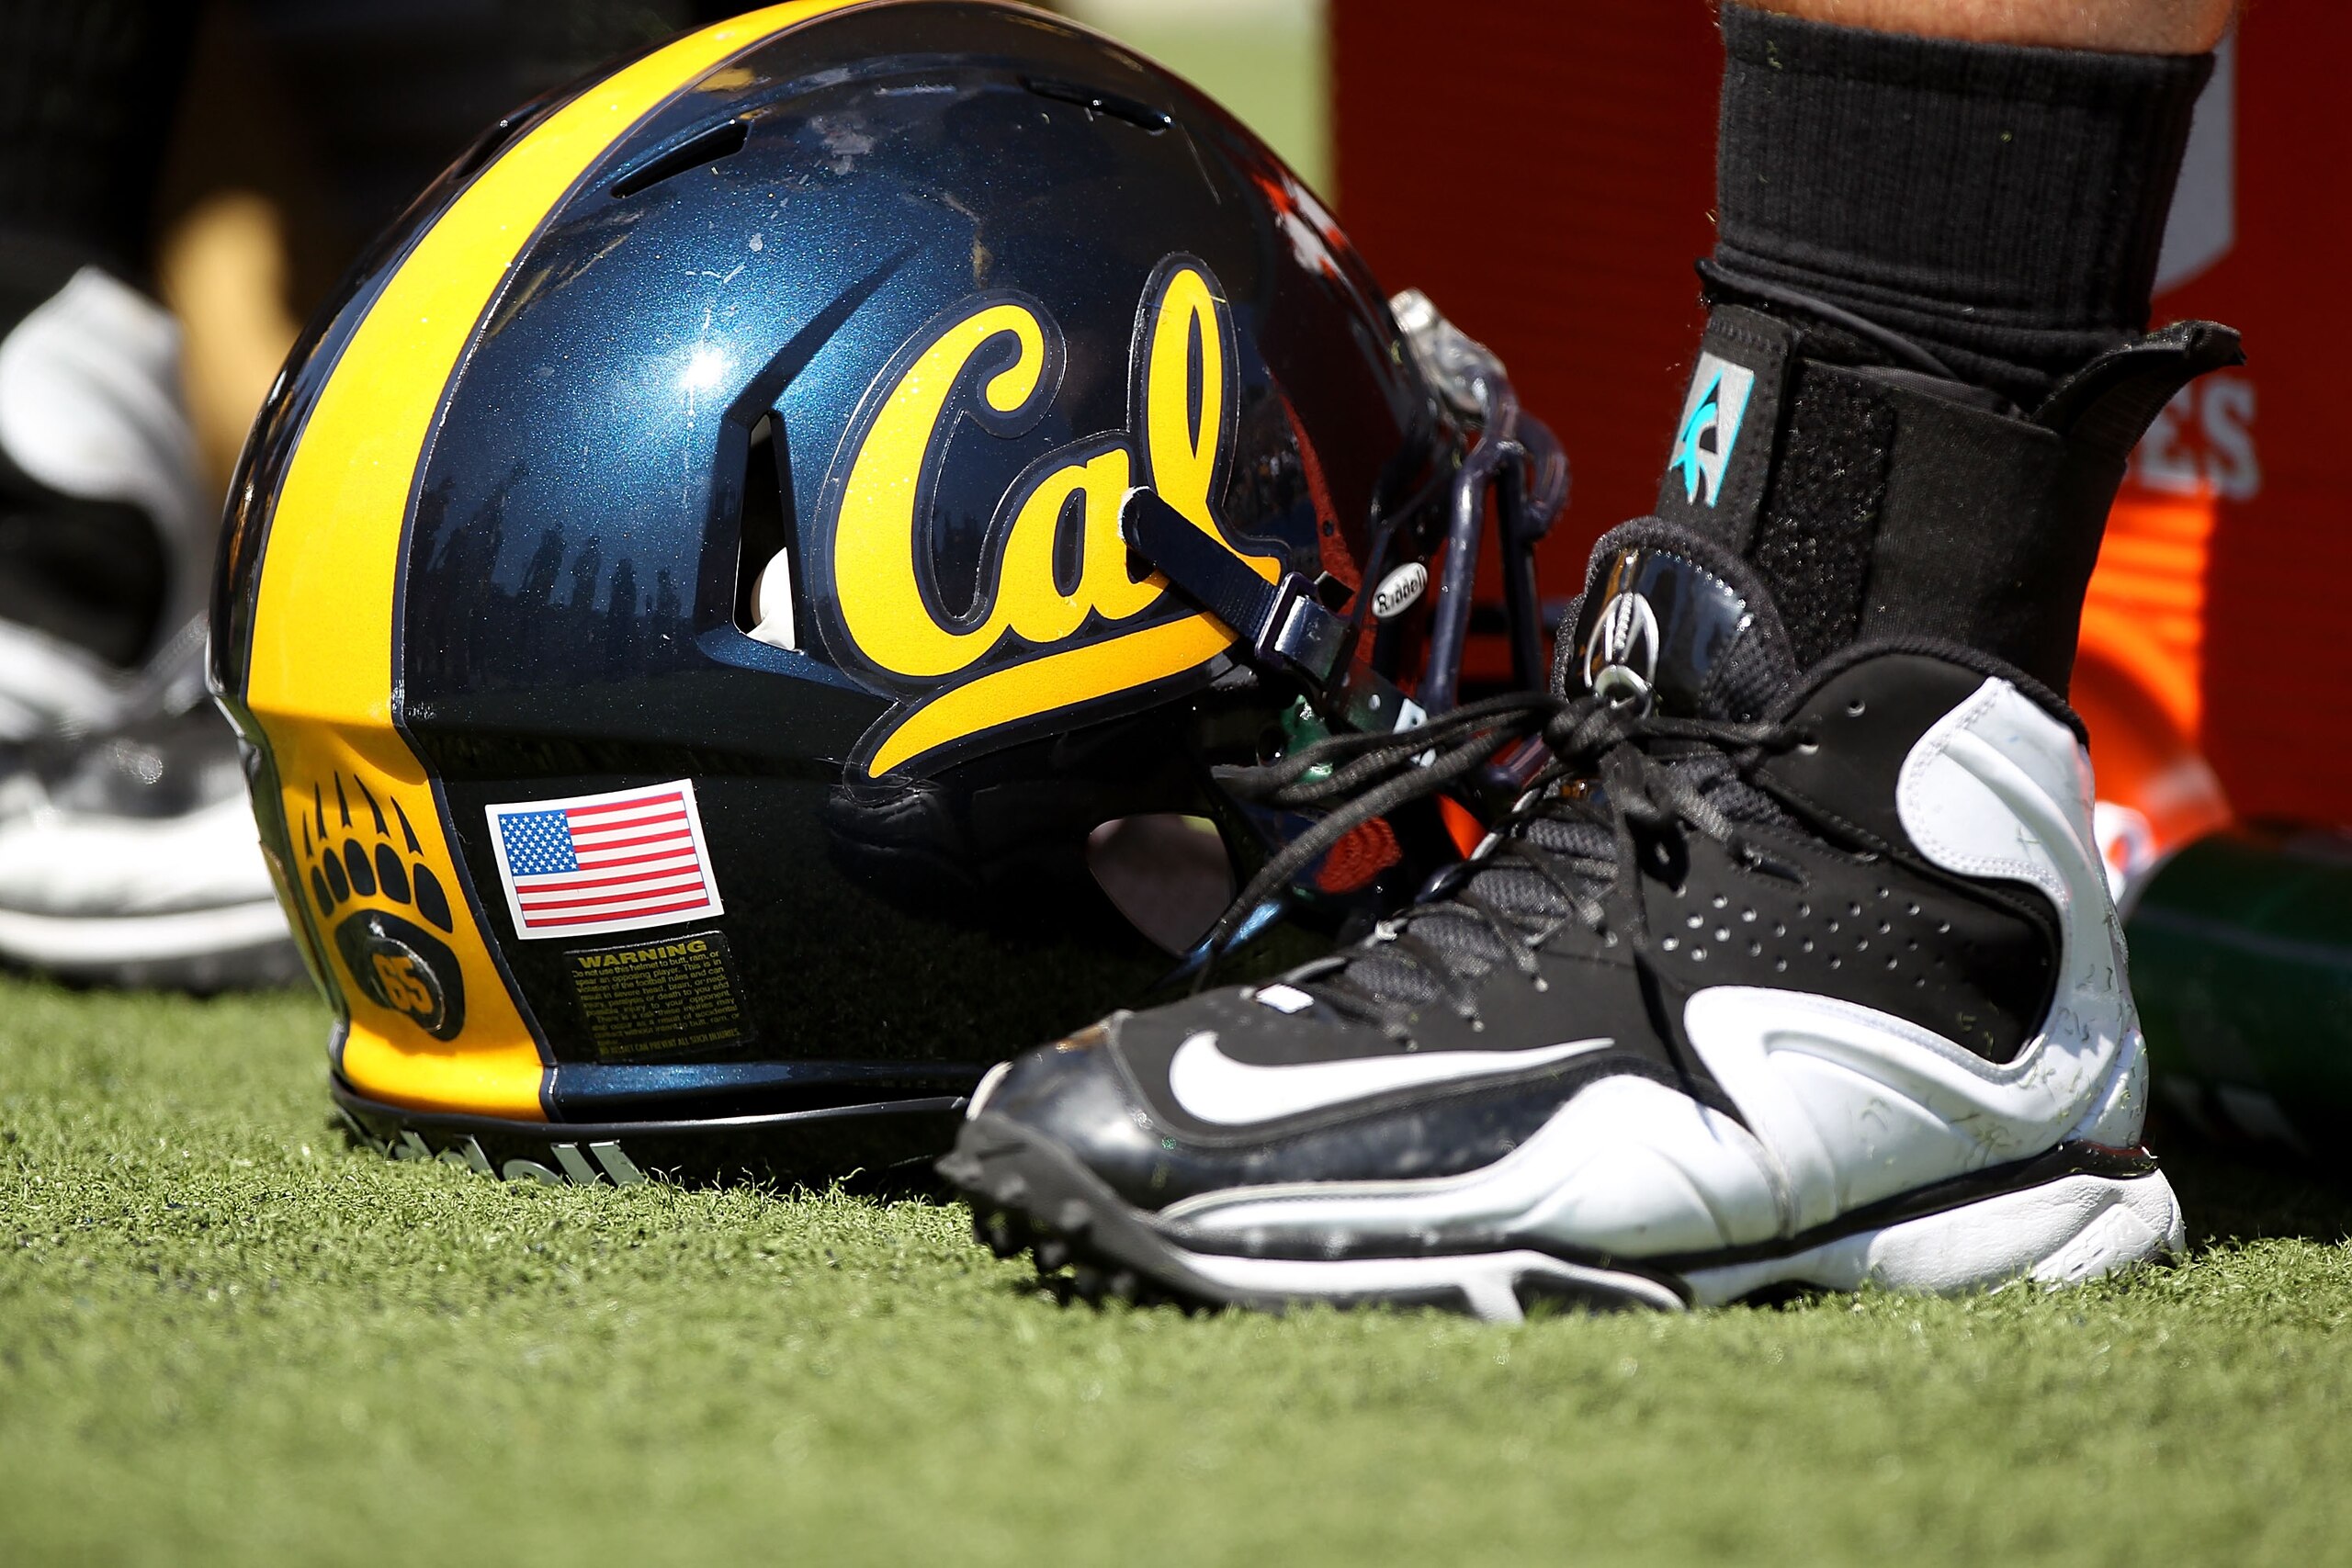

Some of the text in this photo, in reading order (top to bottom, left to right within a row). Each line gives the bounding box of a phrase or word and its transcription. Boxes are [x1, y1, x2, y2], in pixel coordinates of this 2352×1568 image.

[832, 267, 1283, 680] Cal
[1377, 568, 1428, 613] Riddell
[577, 940, 707, 968] WARNING
[629, 962, 659, 972] helmet
[669, 957, 688, 965] butt,
[613, 972, 650, 983] opposing
[653, 968, 680, 977] player.
[636, 976, 666, 987] football
[668, 974, 688, 982] rules
[691, 970, 706, 978] and
[668, 982, 692, 990] brain,
[706, 975, 727, 983] neck
[372, 953, 434, 1015] 65
[657, 991, 681, 1000] death
[695, 987, 710, 995] you
[713, 981, 729, 990] and
[665, 998, 684, 1008] your
[684, 1002, 713, 1012] injuries
[717, 998, 734, 1006] may
[695, 1005, 738, 1018] accidental
